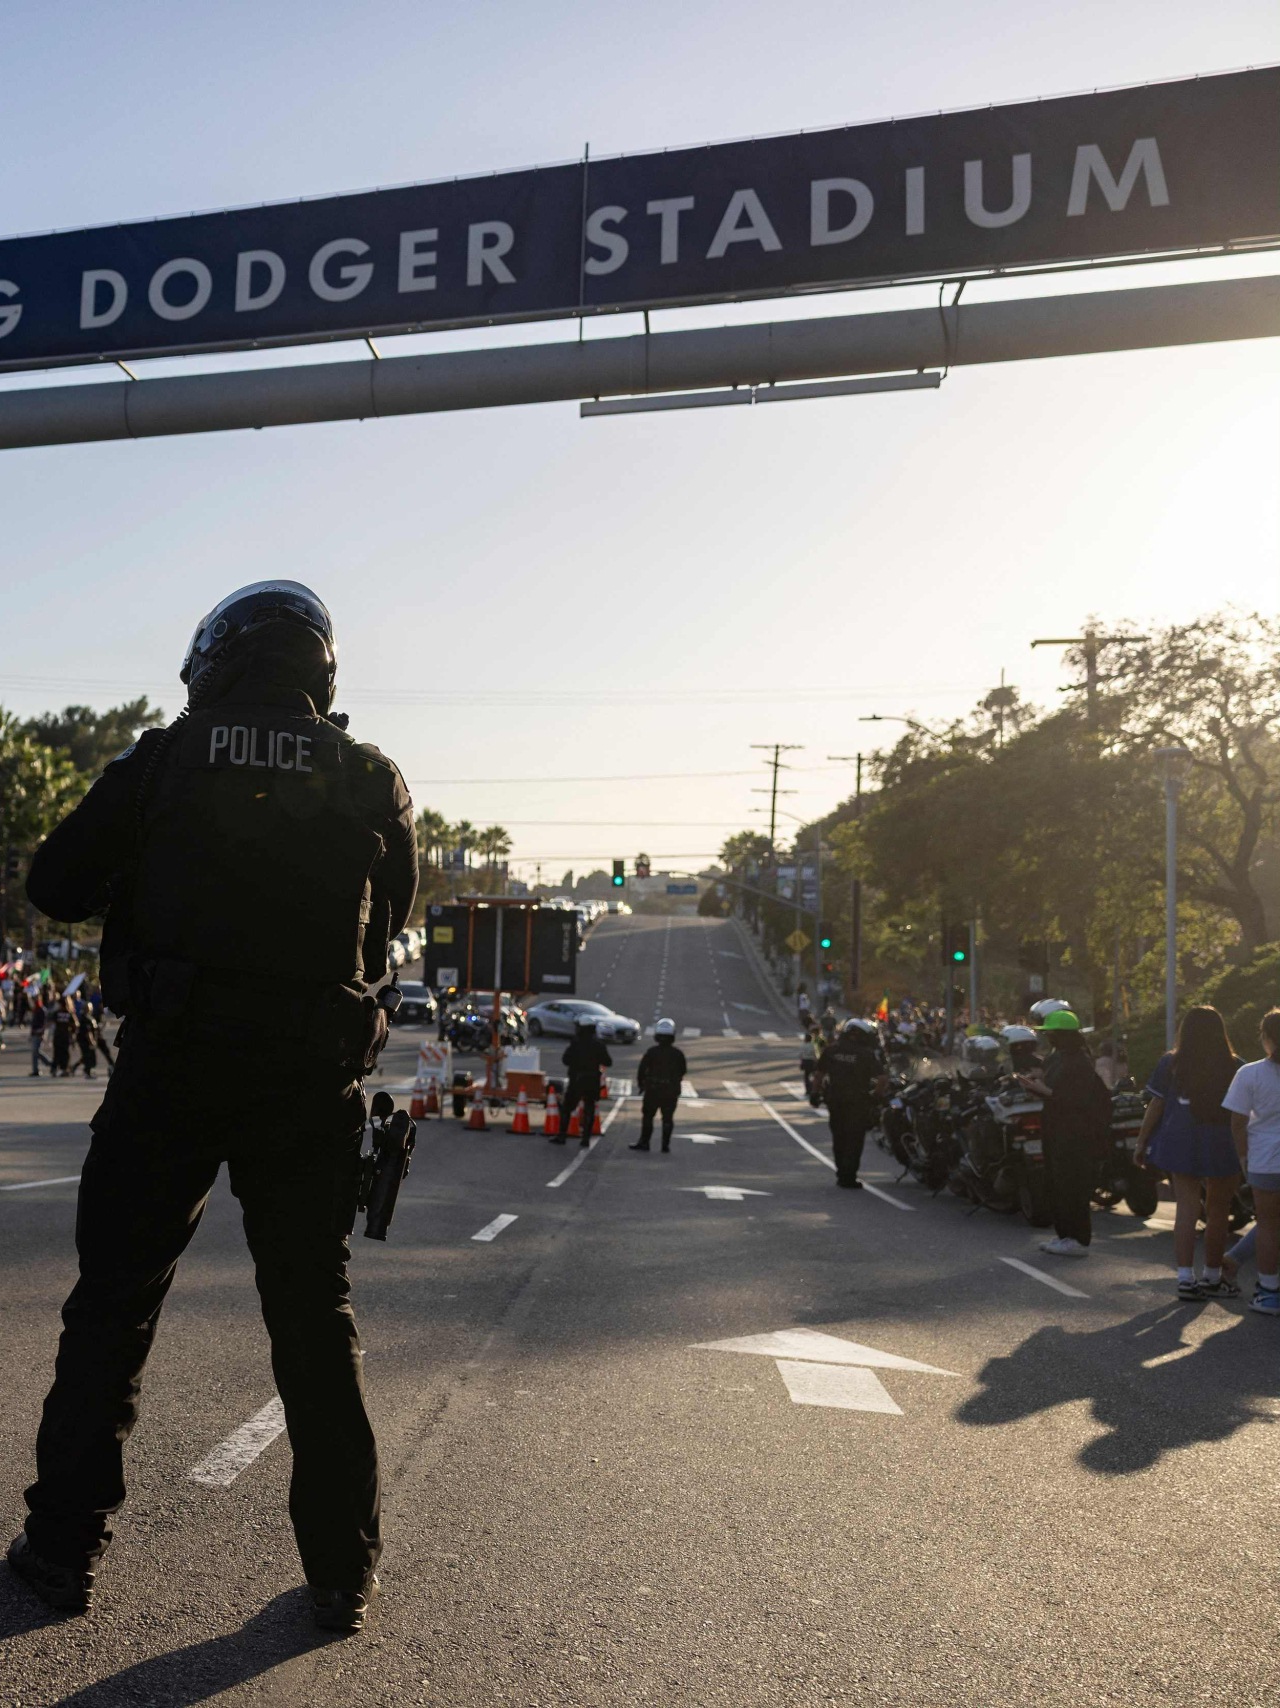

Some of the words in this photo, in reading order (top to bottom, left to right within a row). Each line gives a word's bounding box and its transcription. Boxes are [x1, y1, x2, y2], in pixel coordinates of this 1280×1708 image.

[80, 221, 517, 330] DODGER
[585, 137, 1170, 275] STADIUM
[208, 725, 313, 773] POLICE
